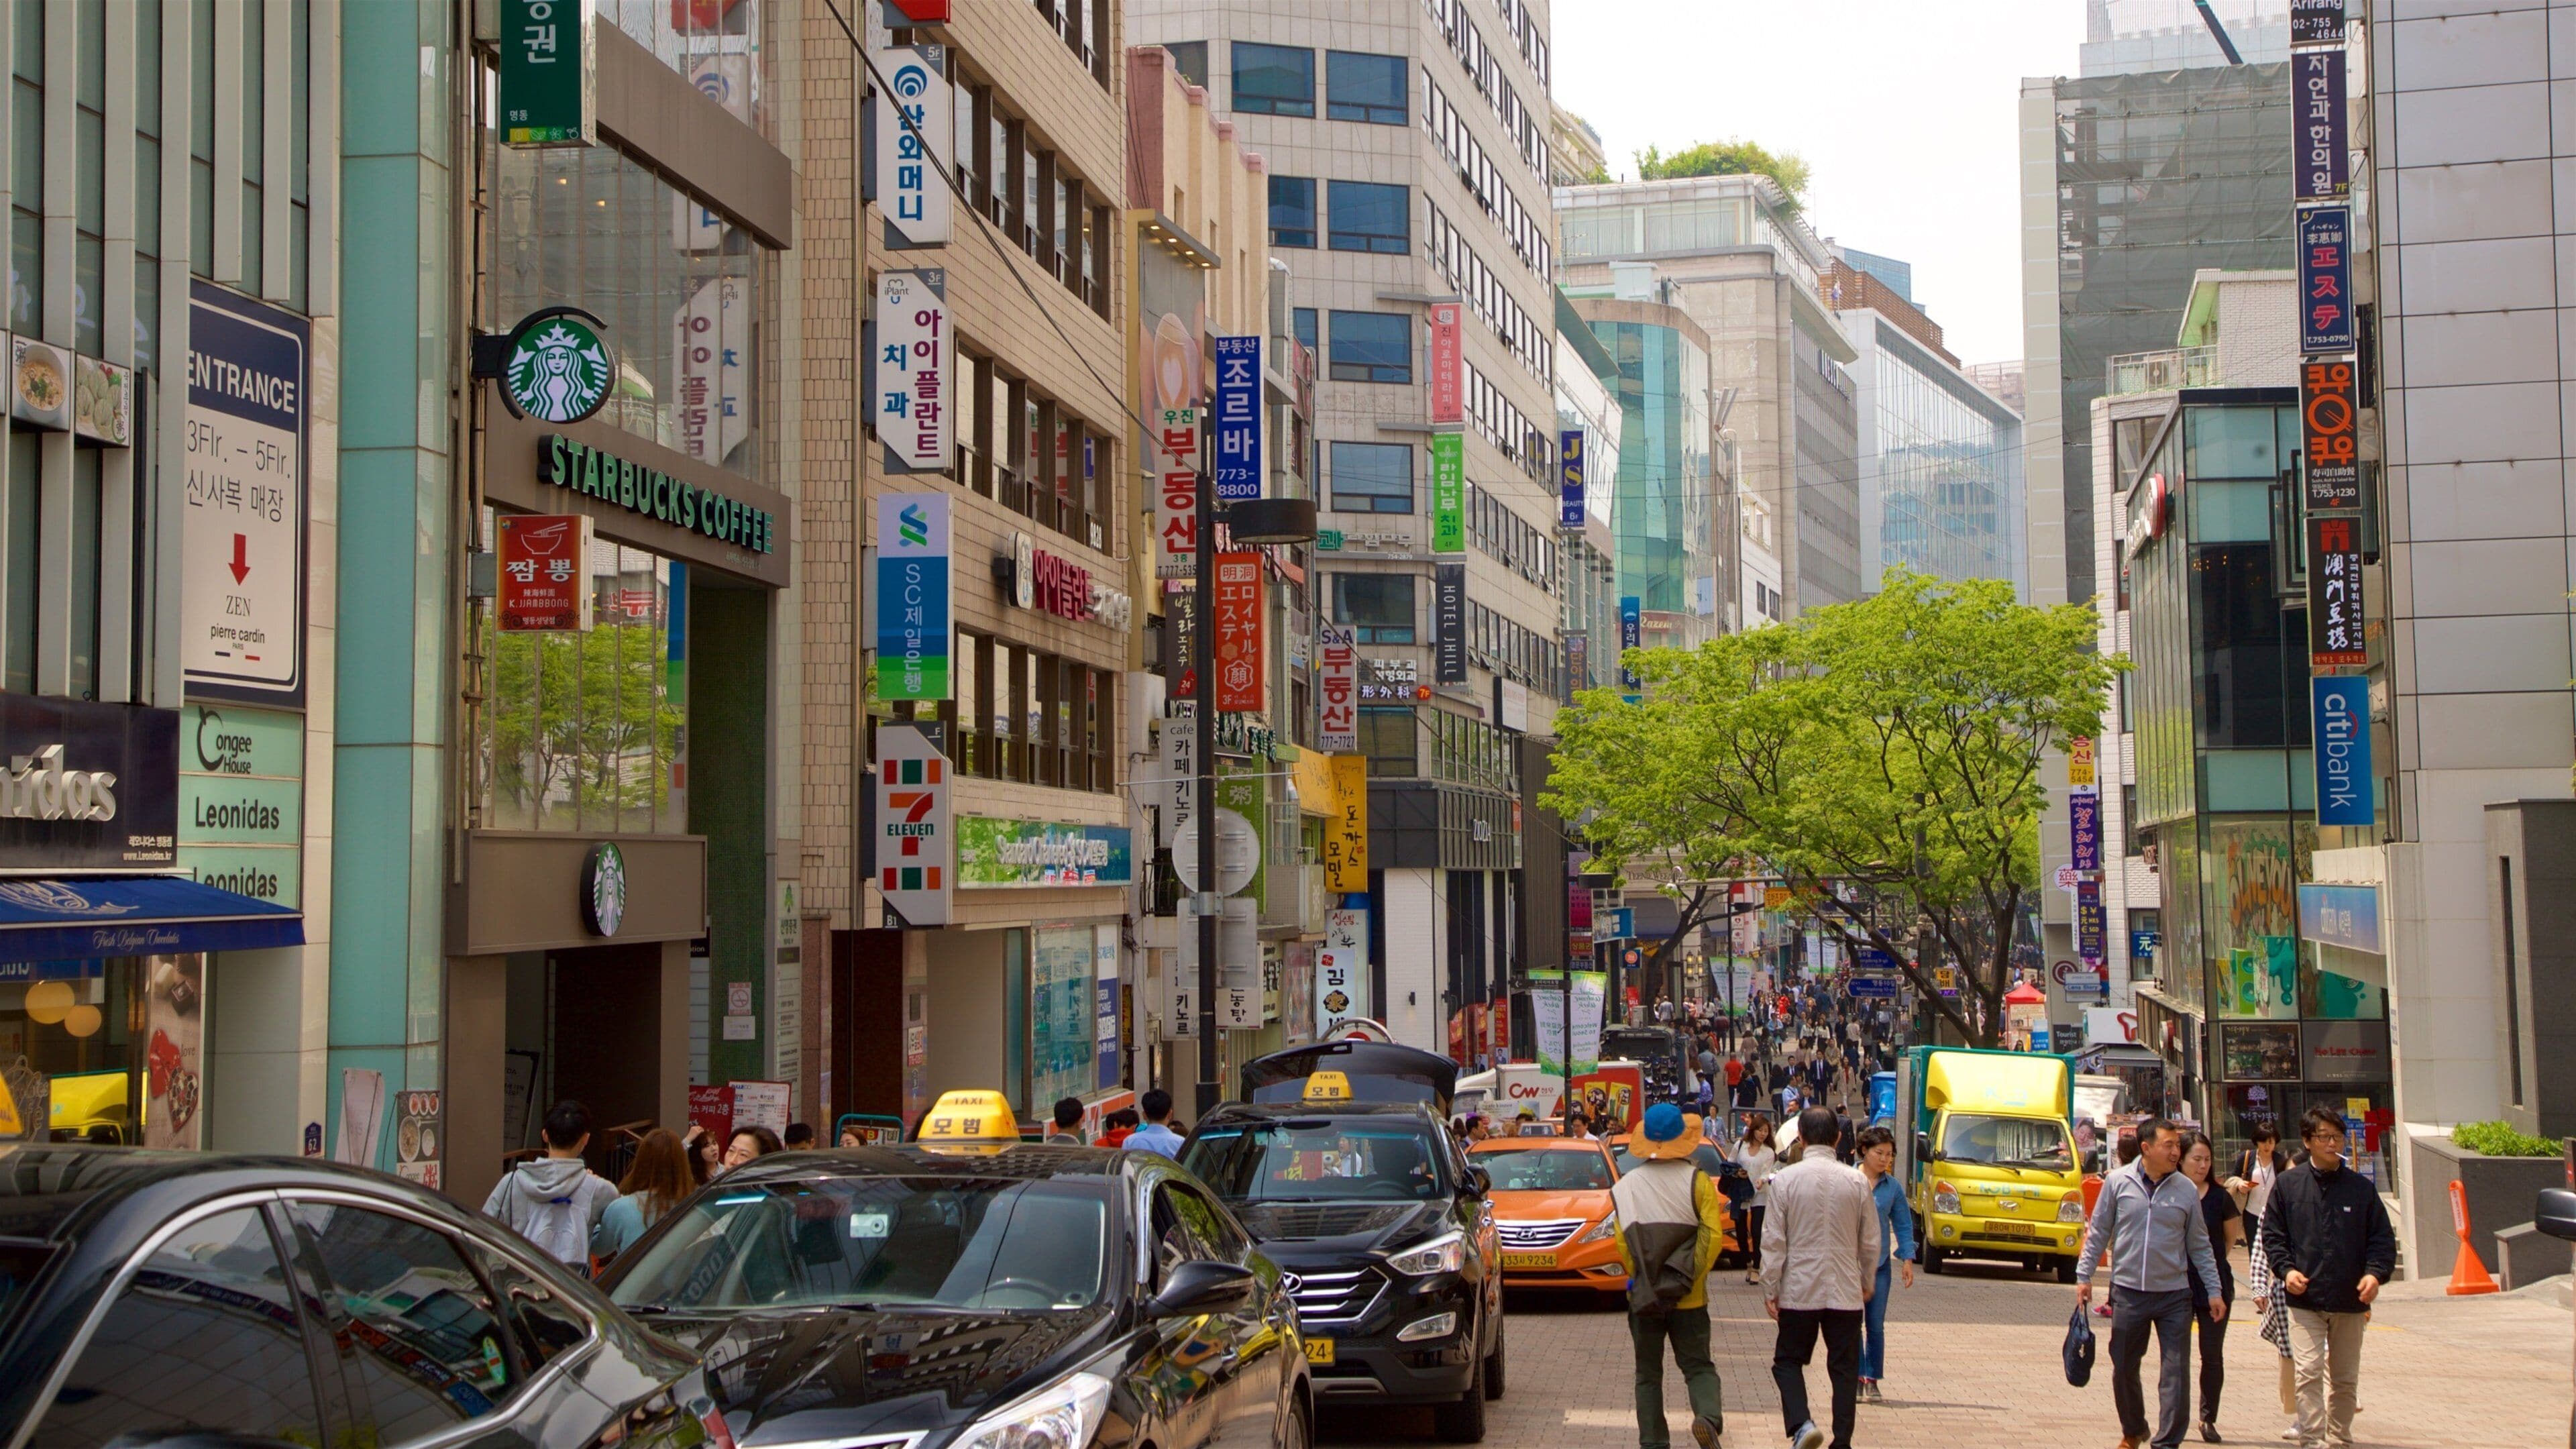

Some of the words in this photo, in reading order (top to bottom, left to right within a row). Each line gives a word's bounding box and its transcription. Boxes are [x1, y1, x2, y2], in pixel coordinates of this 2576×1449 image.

[2292, 17, 2331, 30] 02-755
[2310, 30, 2345, 40] -4644
[928, 47, 941, 58] 5F
[510, 109, 529, 121] 명동
[2308, 54, 2332, 195] 자연과한의원
[2334, 182, 2348, 193] 7F
[2302, 211, 2309, 219] 6
[928, 272, 941, 282] 3F
[884, 286, 909, 296] iPlant
[2311, 246, 2341, 331] エステ
[1217, 339, 1256, 354] 부동산
[2306, 335, 2349, 344] T.753-0790
[189, 350, 295, 414] ENTRANCE
[883, 343, 910, 419] 치과
[914, 309, 943, 458] 아이플란트
[2307, 364, 2351, 394] 쿠우
[1164, 409, 1195, 425] 우진
[1222, 359, 1254, 462] 조르바
[2310, 436, 2355, 466] 쿠우
[256, 440, 290, 478] 5Flr.
[1218, 470, 1255, 480] 773-
[550, 433, 696, 529] STARBUCKS
[700, 488, 774, 554] COFFEE
[1161, 427, 1197, 554] 부동산
[1217, 484, 1257, 496] 8800
[1440, 463, 1457, 511] 라임나무
[2312, 488, 2356, 498] T.753-1230
[187, 470, 243, 513] 신사복
[251, 484, 283, 523] 매장
[1562, 500, 1585, 508] BEAUTY
[2329, 498, 2341, 507] 4F
[1569, 512, 1578, 521] 6F
[1440, 515, 1458, 536] 치과
[1173, 553, 1188, 563] 3층
[1157, 564, 1197, 578] T.777-535
[1222, 566, 1255, 580] 明洞
[1034, 549, 1095, 624] 아이플란트
[226, 594, 252, 617] ZEN
[1444, 586, 1456, 629] HOTEL
[1175, 594, 1196, 634] 벨라
[1220, 586, 1238, 641] エステ
[1240, 585, 1256, 655] ロイヤル
[210, 623, 235, 642] pierre
[238, 625, 265, 644] cardin
[904, 563, 923, 693] SC제일은행
[1321, 629, 1354, 644] S&A
[232, 642, 244, 650] PARIS
[1177, 635, 1188, 667] エステ
[1373, 659, 1417, 670] 피부과
[1181, 680, 1191, 689] 24
[1322, 647, 1354, 733] 부동산
[1222, 694, 1232, 705] 3F
[1419, 689, 1430, 698] 7F
[1170, 724, 1194, 735] cafe
[1321, 735, 1355, 749] 777-7727
[1173, 739, 1191, 775] 카페
[2324, 693, 2359, 808] citibank
[223, 756, 252, 774] House
[195, 796, 280, 830] Leonidas
[123, 851, 172, 861] www.Leonidas.kr
[1328, 841, 1343, 888] 모밀
[2059, 868, 2078, 888] 藥
[886, 915, 898, 926] B1
[93, 930, 115, 948] Fresh
[2139, 936, 2152, 951] 元
[1231, 990, 1247, 1023] 농탕
[1175, 994, 1190, 1035] 키노르
[1311, 1086, 1340, 1096] 모범
[955, 1096, 984, 1106] TAXI
[702, 1106, 716, 1114] 커피
[717, 1104, 730, 1116] 2층
[932, 1117, 981, 1134] 모범
[308, 1138, 317, 1151] 62
[2012, 1224, 2031, 1233] 1073
[1527, 1255, 1554, 1265] 9234
